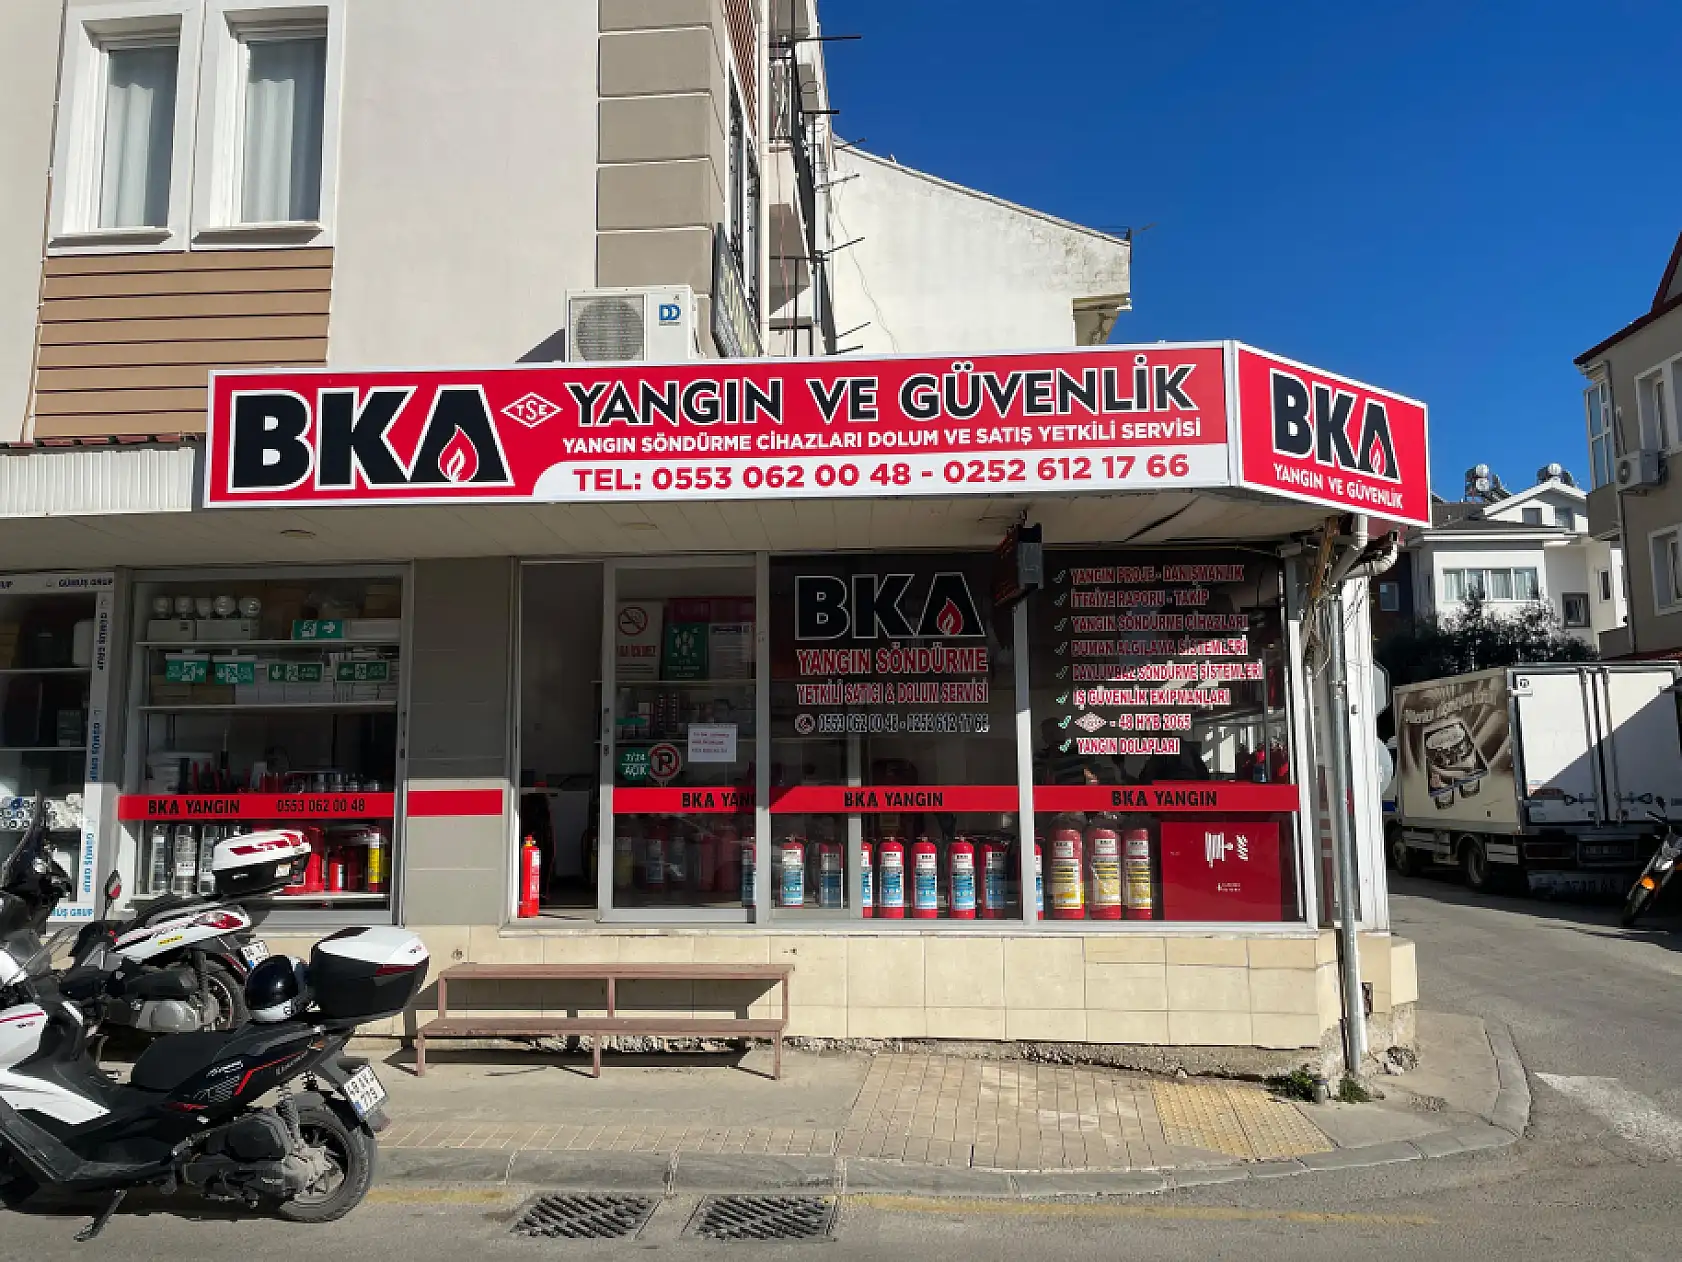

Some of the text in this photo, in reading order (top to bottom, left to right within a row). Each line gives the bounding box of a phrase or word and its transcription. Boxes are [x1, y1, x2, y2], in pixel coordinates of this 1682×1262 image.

[563, 354, 1199, 427] YANGIN VE GÜVENLİK
[514, 397, 549, 422] TSE
[563, 417, 1202, 454] YANGIN SÖNDÜRME CİHAZLARI DOLUM VE SATIŞ YETKİLİ SERVİSİ
[1270, 368, 1402, 484] BKA
[228, 384, 515, 494] BKA
[573, 468, 641, 491] TEL:
[652, 466, 732, 490] 0553
[742, 464, 804, 489] 062
[815, 463, 860, 488] 00
[870, 462, 911, 486] 48
[943, 458, 1027, 484] 0252
[1037, 457, 1092, 481] 612
[1102, 455, 1136, 479] 17
[1146, 453, 1190, 478] 66
[1273, 462, 1403, 510] YANGIN VE GÜVENLİK
[1070, 568, 1115, 585] YANGIN
[1117, 566, 1154, 583] PROJE
[1163, 565, 1244, 585] DANIŞMANLIK
[795, 572, 987, 640] BKA
[1071, 587, 1115, 607] İTFAİYE
[1117, 590, 1165, 607] RAPORU
[1174, 586, 1209, 606] TAKİP
[1071, 610, 1249, 632] YANGIN SÖNDÜRME CİHAZLARI
[1071, 635, 1248, 657] DUMAN ALGILAMA SİSTEMLERİ
[796, 642, 988, 675] YANGIN SÖNDÜRME
[1137, 660, 1198, 681] SÖNDÜRME
[1200, 659, 1264, 680] SİSTEMLERİ
[796, 679, 844, 705] YETKİLİ
[845, 683, 883, 703] SATICI
[898, 682, 939, 703] DOLUM
[942, 677, 988, 703] SERVİSİ
[1088, 685, 1148, 705] GÜVENLİK
[1150, 686, 1231, 706] EKİPMANLARI
[819, 713, 844, 733] 0553
[846, 713, 868, 733] 062
[869, 713, 882, 733] 00
[1119, 714, 1133, 730] 48
[1134, 714, 1160, 731] HYB
[1162, 714, 1192, 731] 2065
[1076, 738, 1180, 754] YANGIN DOLAPLARI
[148, 799, 240, 816] BKA YANGIN
[276, 798, 365, 813] 0553 062 00 48
[682, 792, 715, 808] BKA
[844, 791, 944, 808] BKA YANGIN
[1111, 790, 1218, 807] BKA YANGIN
[70, 907, 94, 919] GRUP
